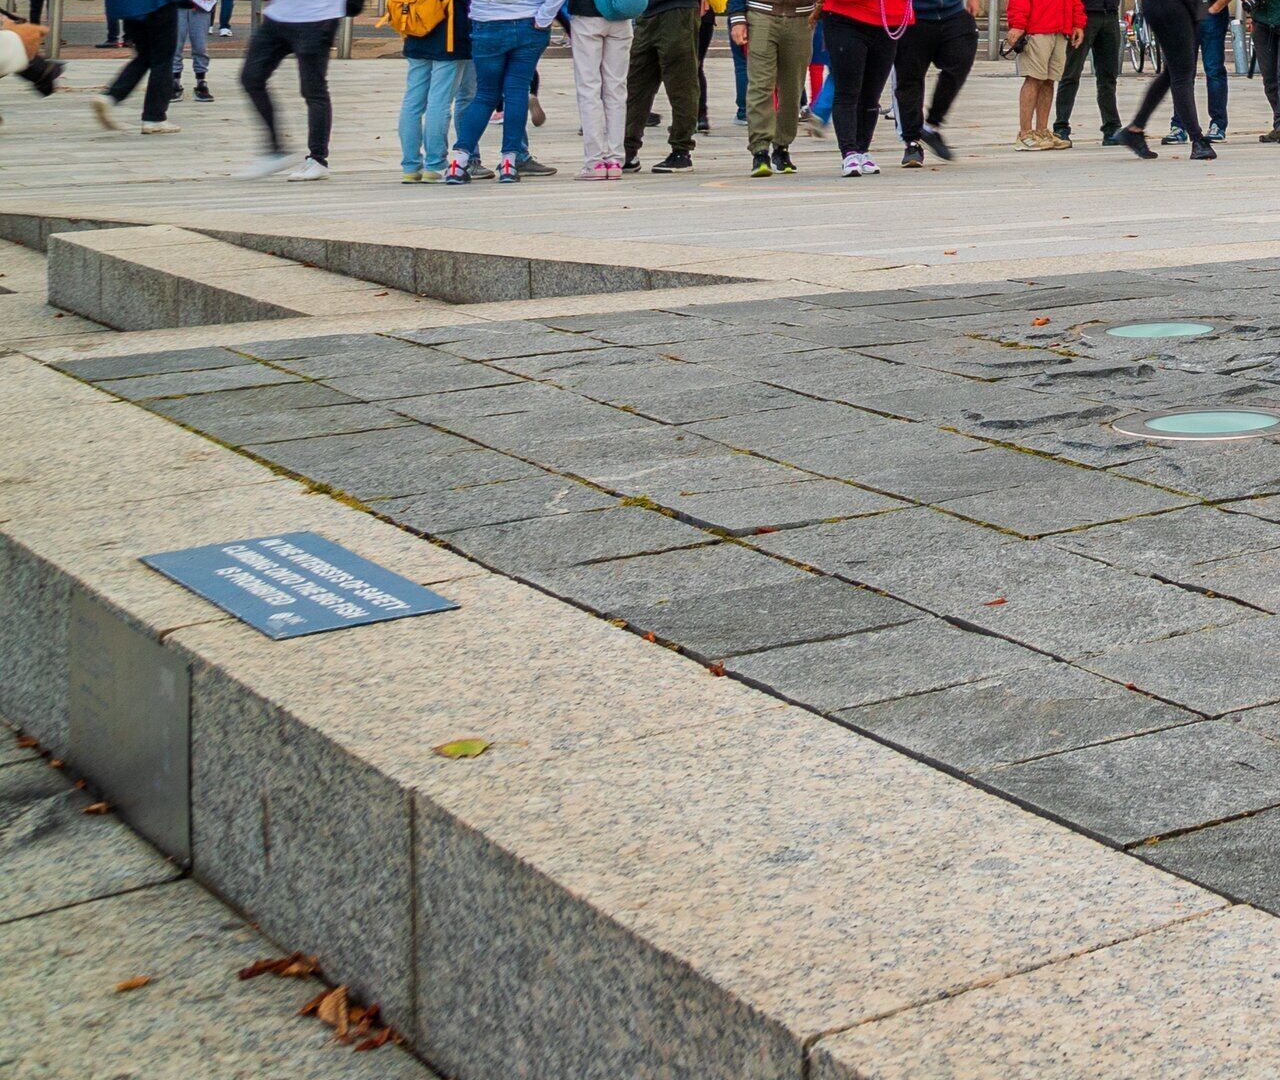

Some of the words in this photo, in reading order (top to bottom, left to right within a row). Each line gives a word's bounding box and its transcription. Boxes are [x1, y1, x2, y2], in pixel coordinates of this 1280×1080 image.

[259, 538, 286, 547] IN
[268, 543, 305, 557] THE
[215, 566, 243, 575] IS
[286, 553, 355, 582] INTERESTS
[221, 544, 279, 570] CLIMBING
[263, 567, 307, 585] ONTO
[291, 581, 327, 596] THE
[309, 592, 345, 606] BIG
[327, 602, 370, 619] FISH
[224, 572, 297, 606] PROHIBITED
[338, 579, 370, 591] OF
[353, 587, 411, 611] SAFETY
